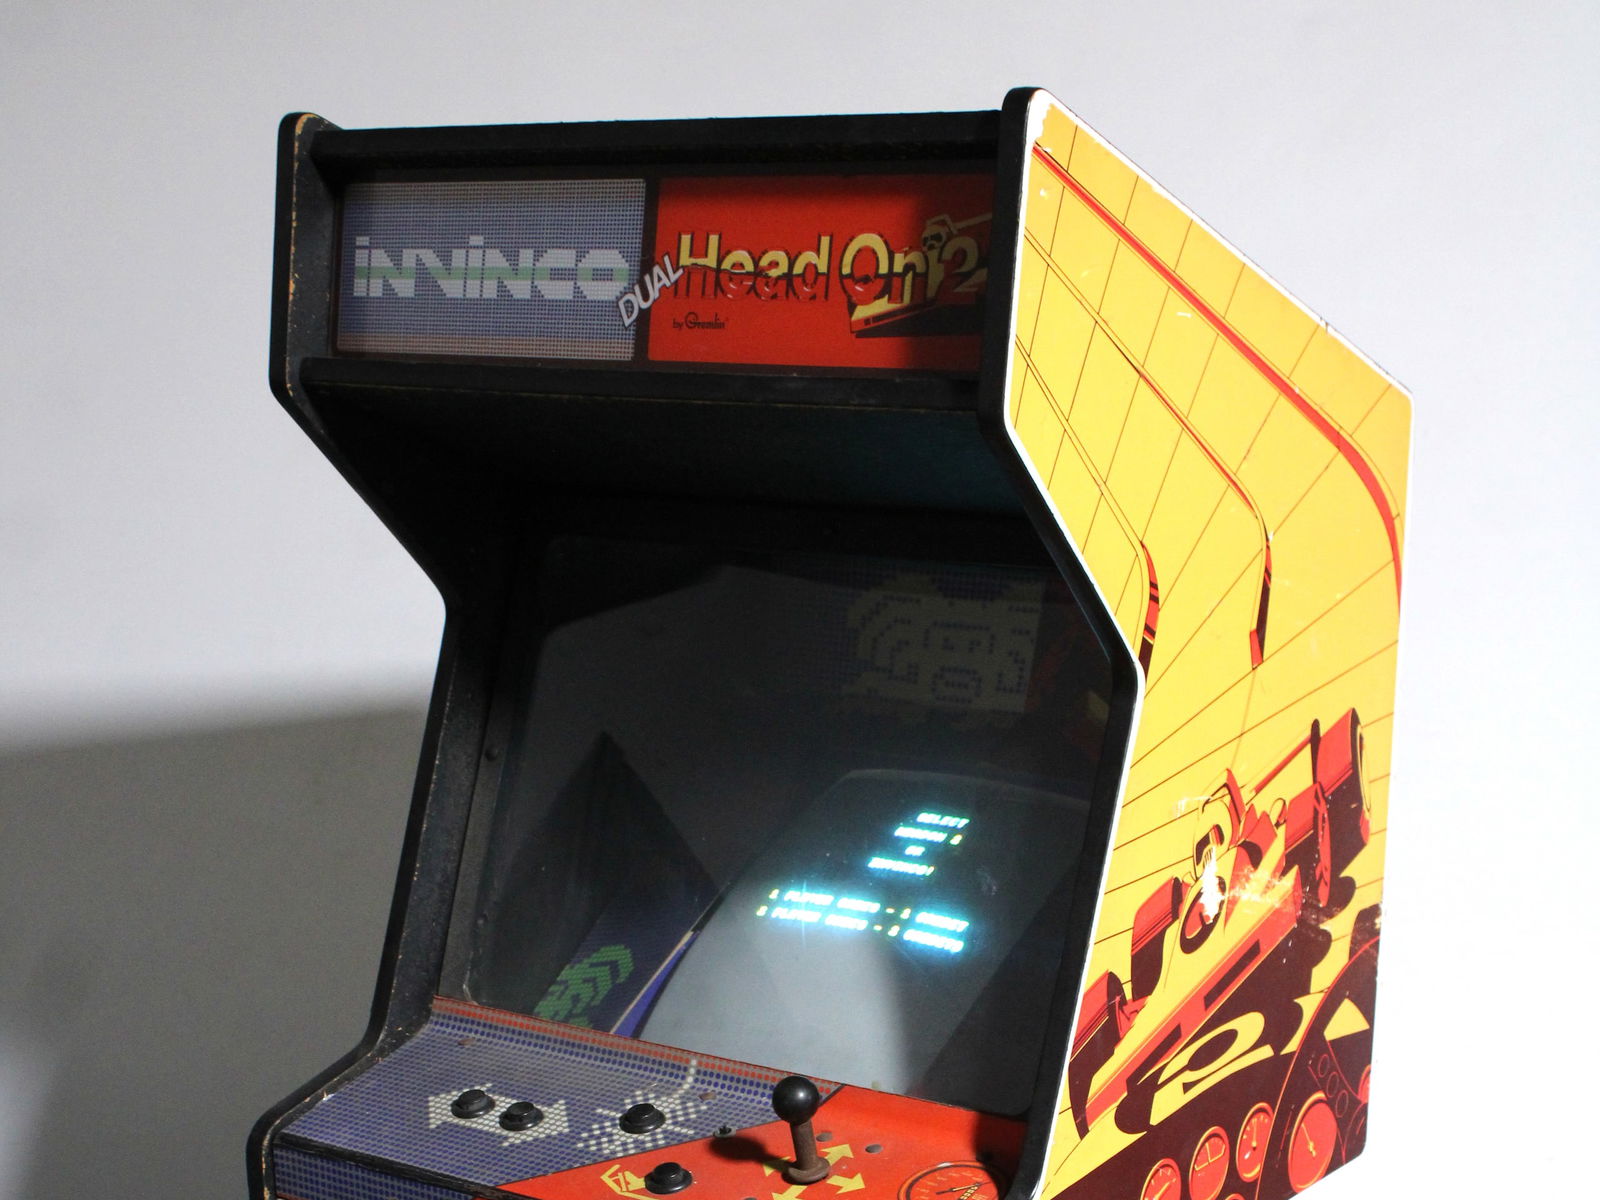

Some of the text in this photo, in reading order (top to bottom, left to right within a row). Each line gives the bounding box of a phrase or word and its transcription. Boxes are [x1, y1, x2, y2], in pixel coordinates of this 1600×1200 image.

[617, 253, 684, 328] DUAL
[674, 232, 832, 300] Head
[839, 232, 928, 305] On
[672, 317, 683, 331] by
